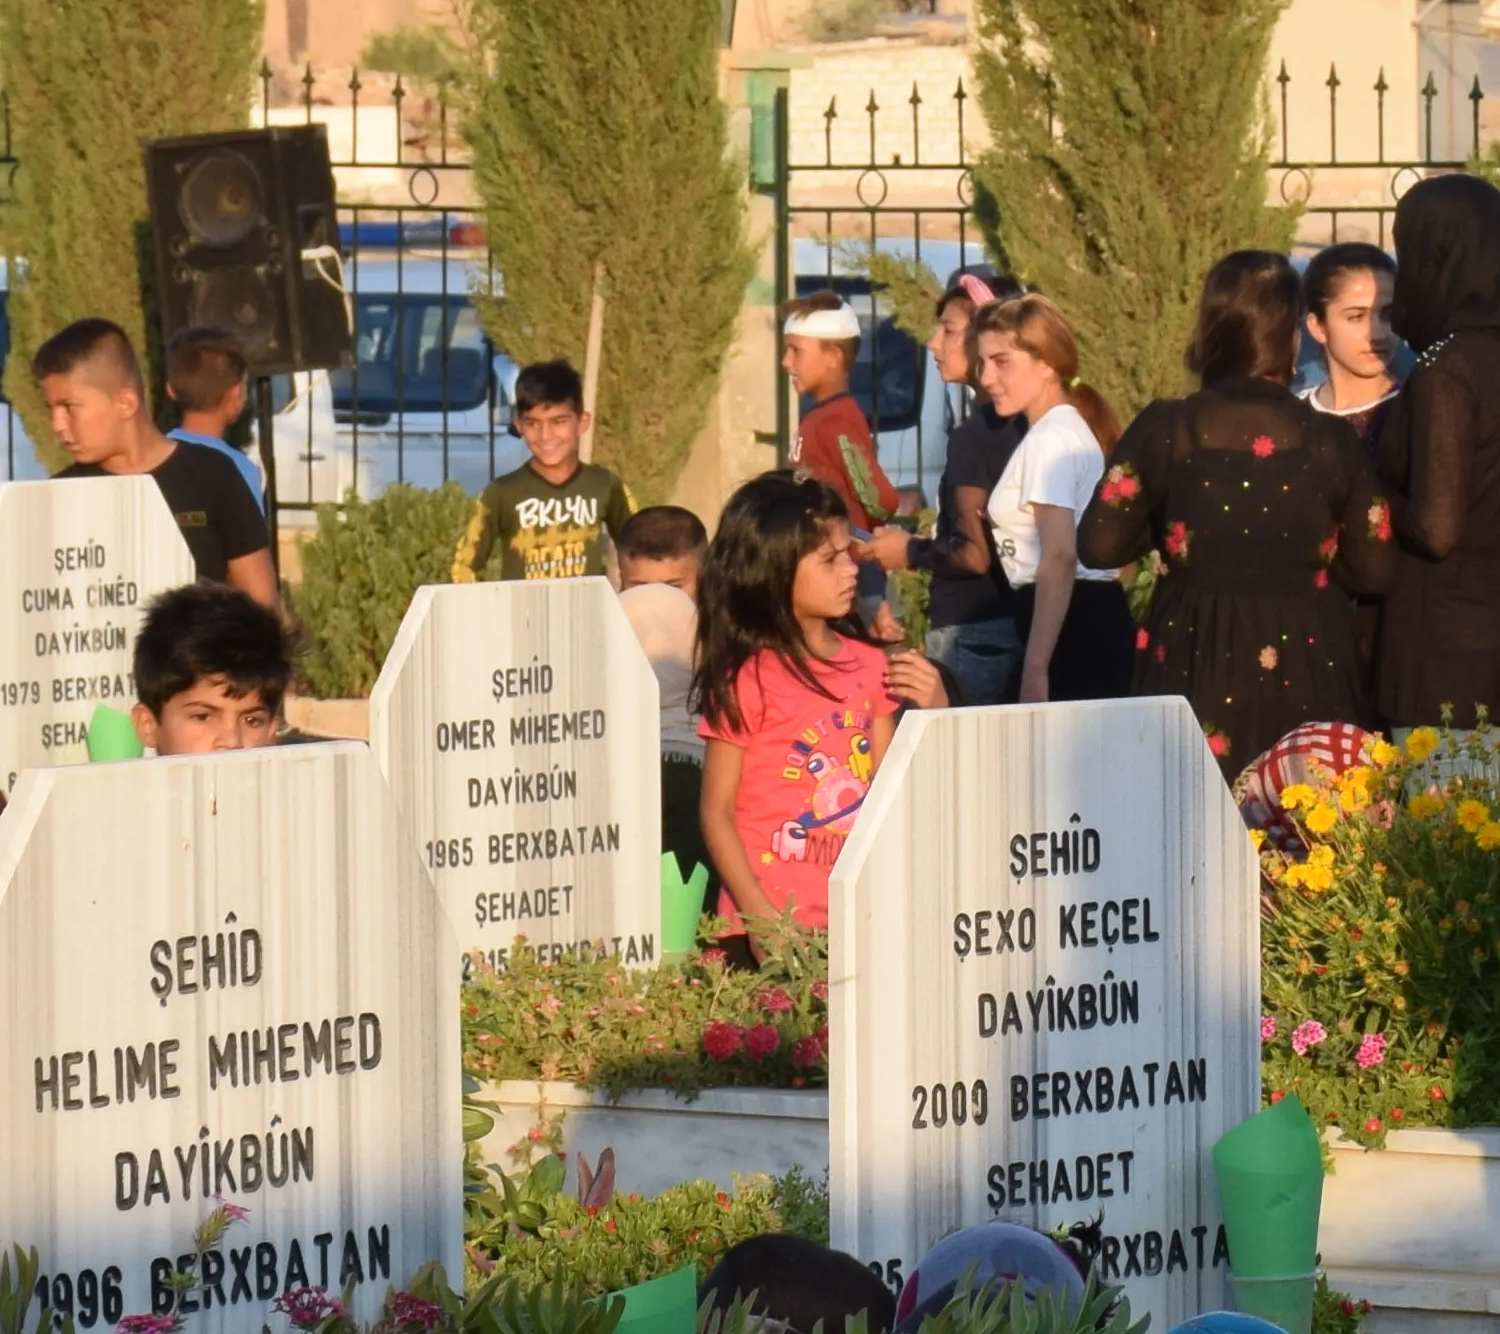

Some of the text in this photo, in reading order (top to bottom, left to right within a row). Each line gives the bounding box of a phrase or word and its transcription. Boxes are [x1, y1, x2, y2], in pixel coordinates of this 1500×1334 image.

[515, 494, 598, 529] BKLYN
[22, 588, 74, 613] CUMA
[0, 674, 137, 706] 1979 BERXBAT
[492, 654, 553, 703] ŞEHÎD
[41, 723, 88, 750] ŞEHA
[436, 718, 496, 752] OMER
[781, 718, 829, 781] DONUT
[426, 823, 620, 869] 1965 BERXBATAN
[1009, 814, 1100, 885] ŞEHÎD
[475, 885, 573, 927] ŞEHADET
[953, 897, 1160, 964] ŞEXO KEÇEL
[149, 911, 263, 1007] ŞEHÎD
[977, 970, 1140, 1039] DAYÎKBÛN
[34, 1011, 383, 1113] HELIME MIHEMED
[911, 1057, 1207, 1131] 2000 BERXBATAN
[115, 1115, 315, 1211] DAYÎKBÛN
[987, 1150, 1134, 1217] ŞEHADET
[34, 1223, 392, 1330] 1996 BERXBATAN
[1098, 1223, 1231, 1280] RXBATA
